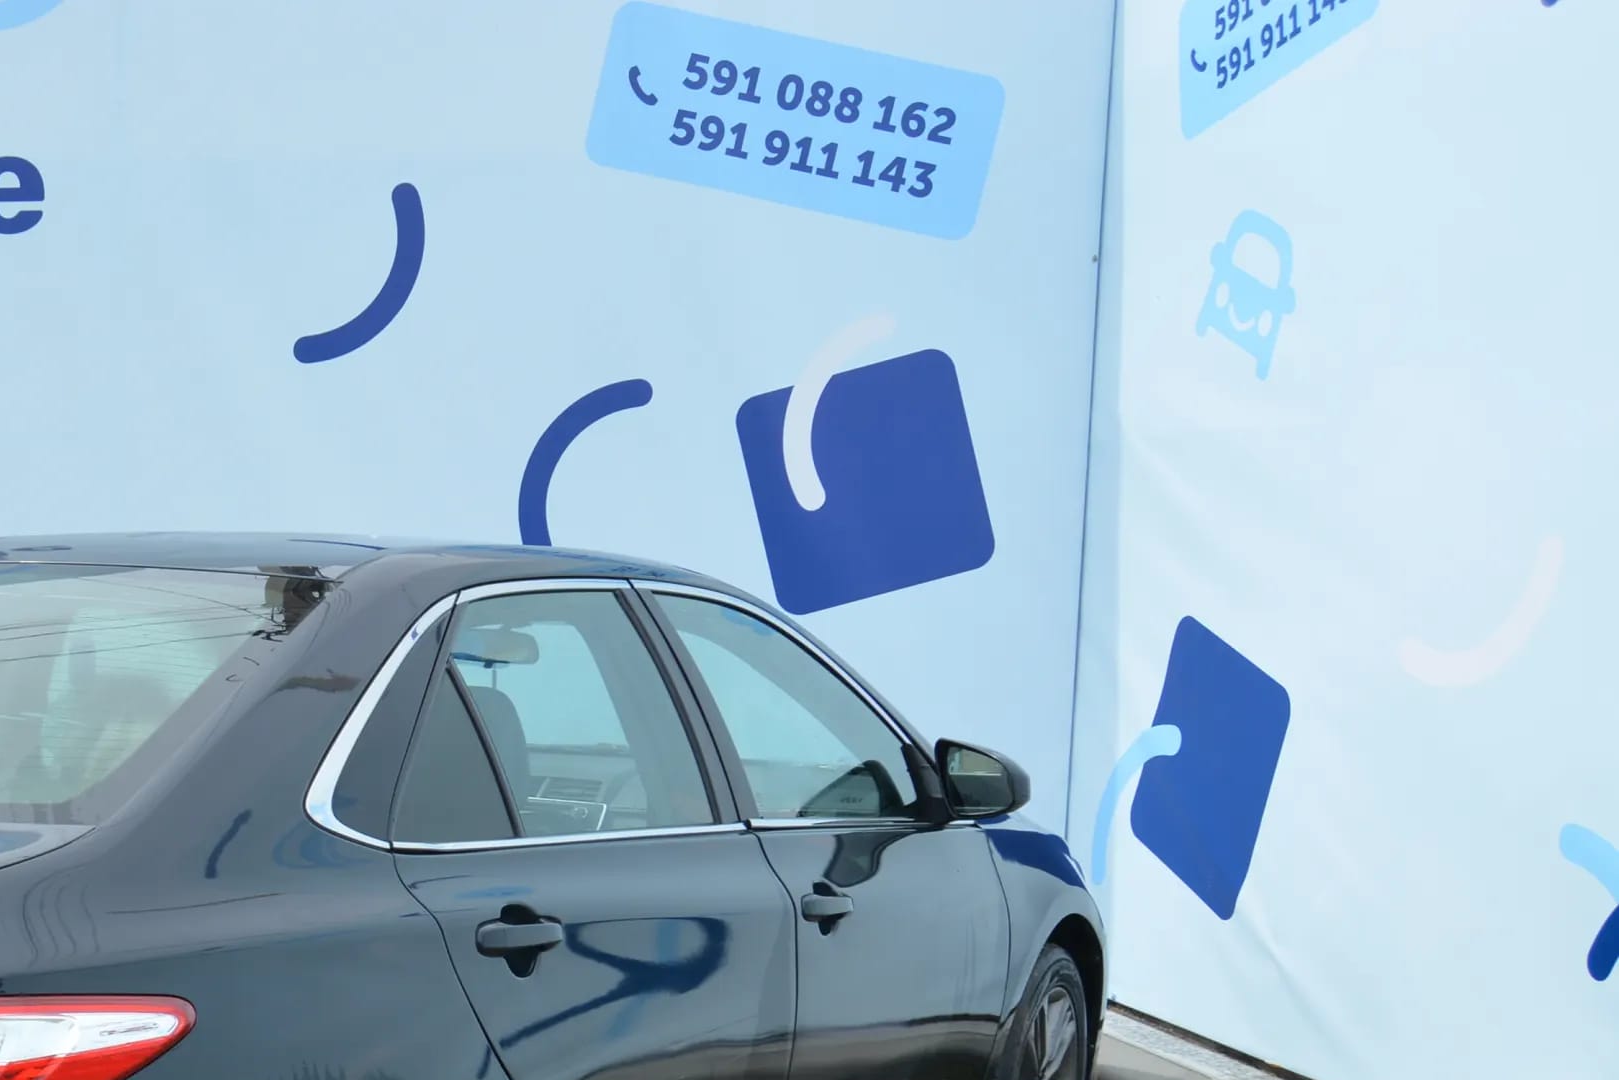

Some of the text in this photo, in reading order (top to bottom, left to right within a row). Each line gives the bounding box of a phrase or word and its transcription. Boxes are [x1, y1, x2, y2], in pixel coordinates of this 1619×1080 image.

[1214, 0, 1254, 41] 591
[1216, 36, 1256, 89] 591
[1260, 3, 1302, 59] 911
[682, 52, 957, 146] 591 088 162
[668, 108, 937, 199] 591 911 143
